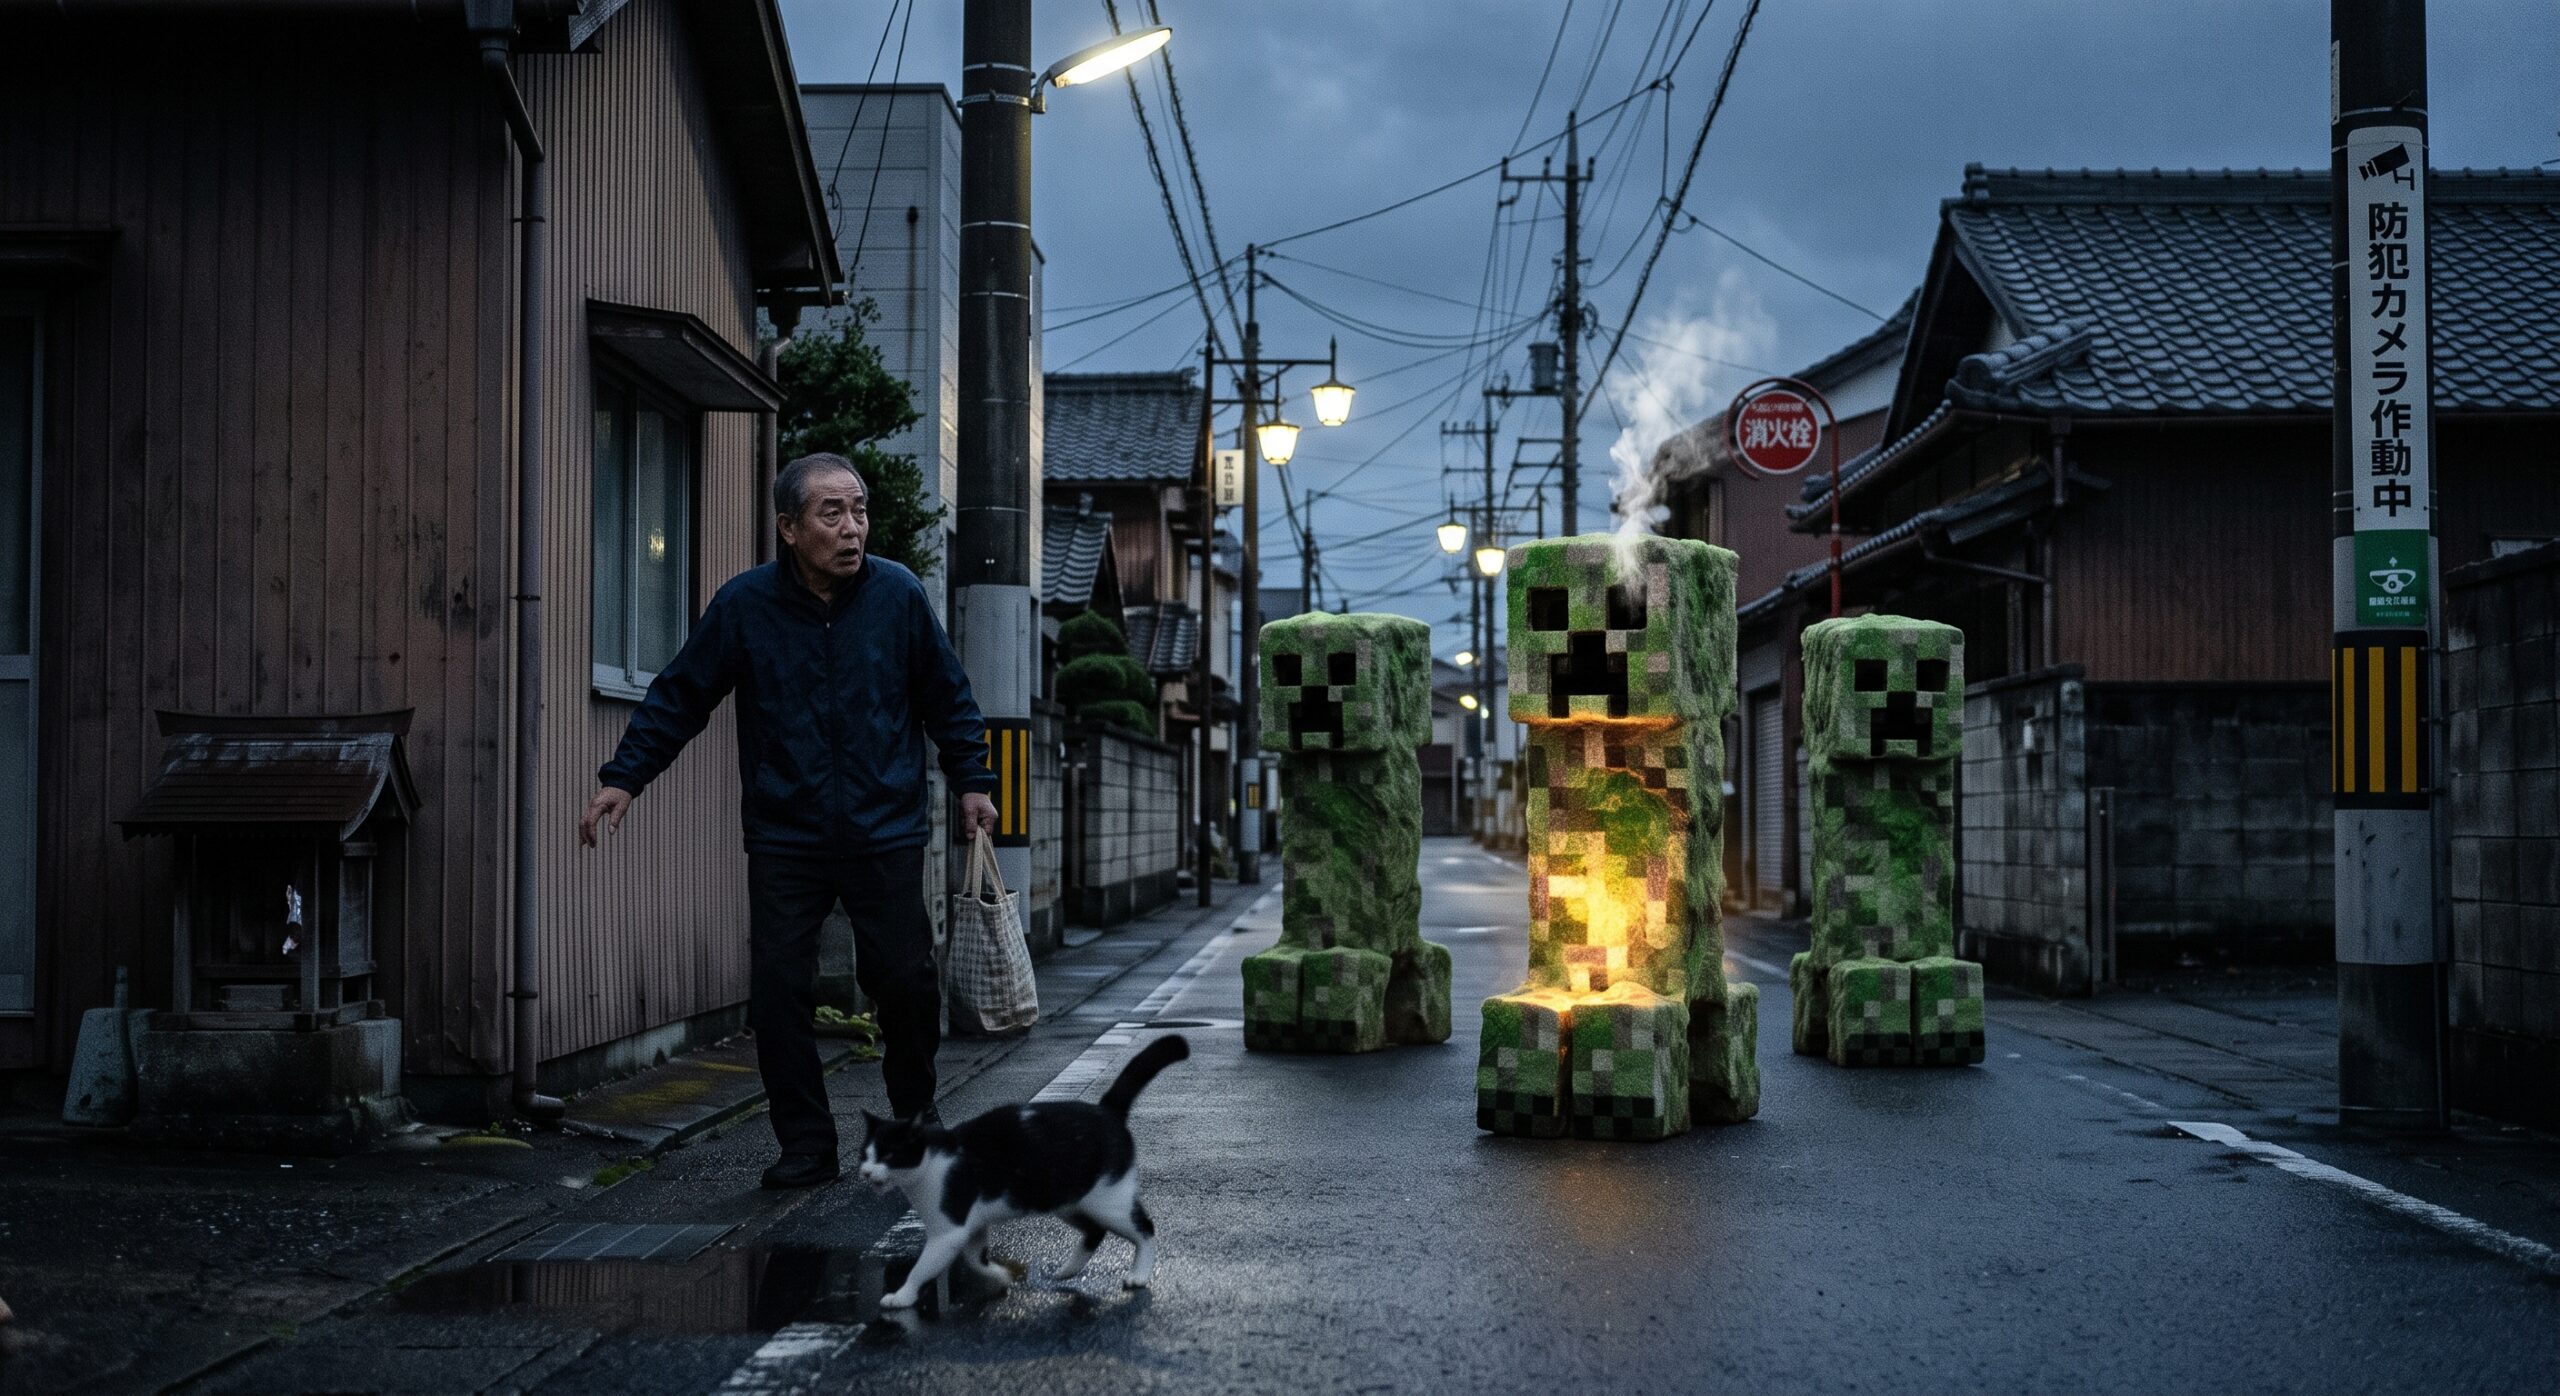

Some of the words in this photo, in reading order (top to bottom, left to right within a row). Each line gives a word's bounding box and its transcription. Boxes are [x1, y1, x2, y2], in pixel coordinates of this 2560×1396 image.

[1744, 417, 1813, 448] 消火栓
[2368, 202, 2411, 517] 防犯カメラ作動中
